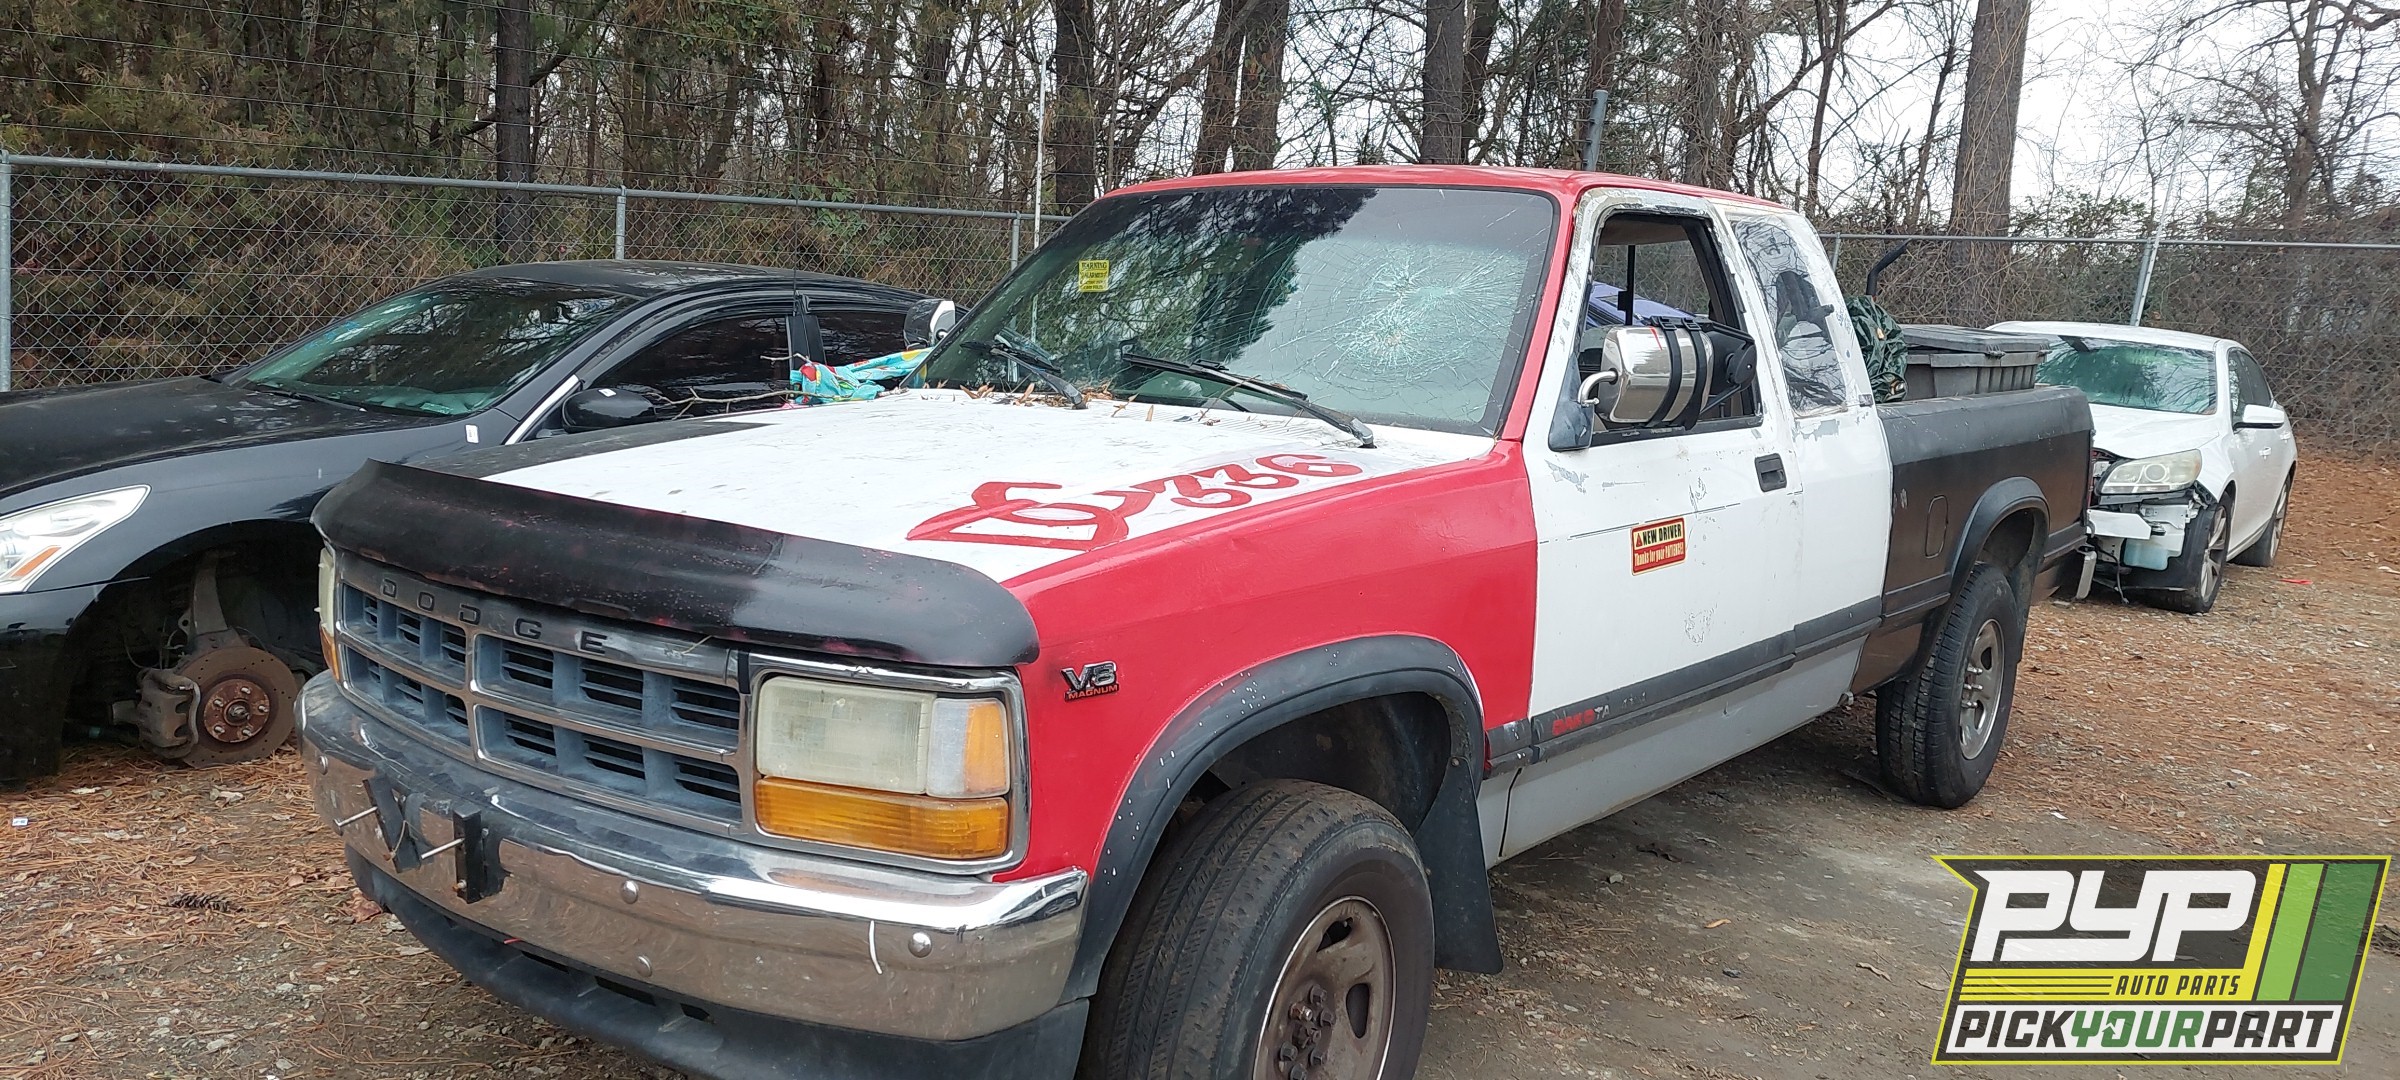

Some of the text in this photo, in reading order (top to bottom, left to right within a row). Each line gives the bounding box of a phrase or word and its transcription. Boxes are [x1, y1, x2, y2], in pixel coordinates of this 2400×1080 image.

[1642, 523, 1682, 546] NEW DRIVER
[1634, 550, 1650, 567] Thanks
[1655, 548, 1665, 563] your
[381, 578, 608, 655] DODGE
[1060, 660, 1117, 690] V8
[1067, 684, 1119, 700] MAGNUM
